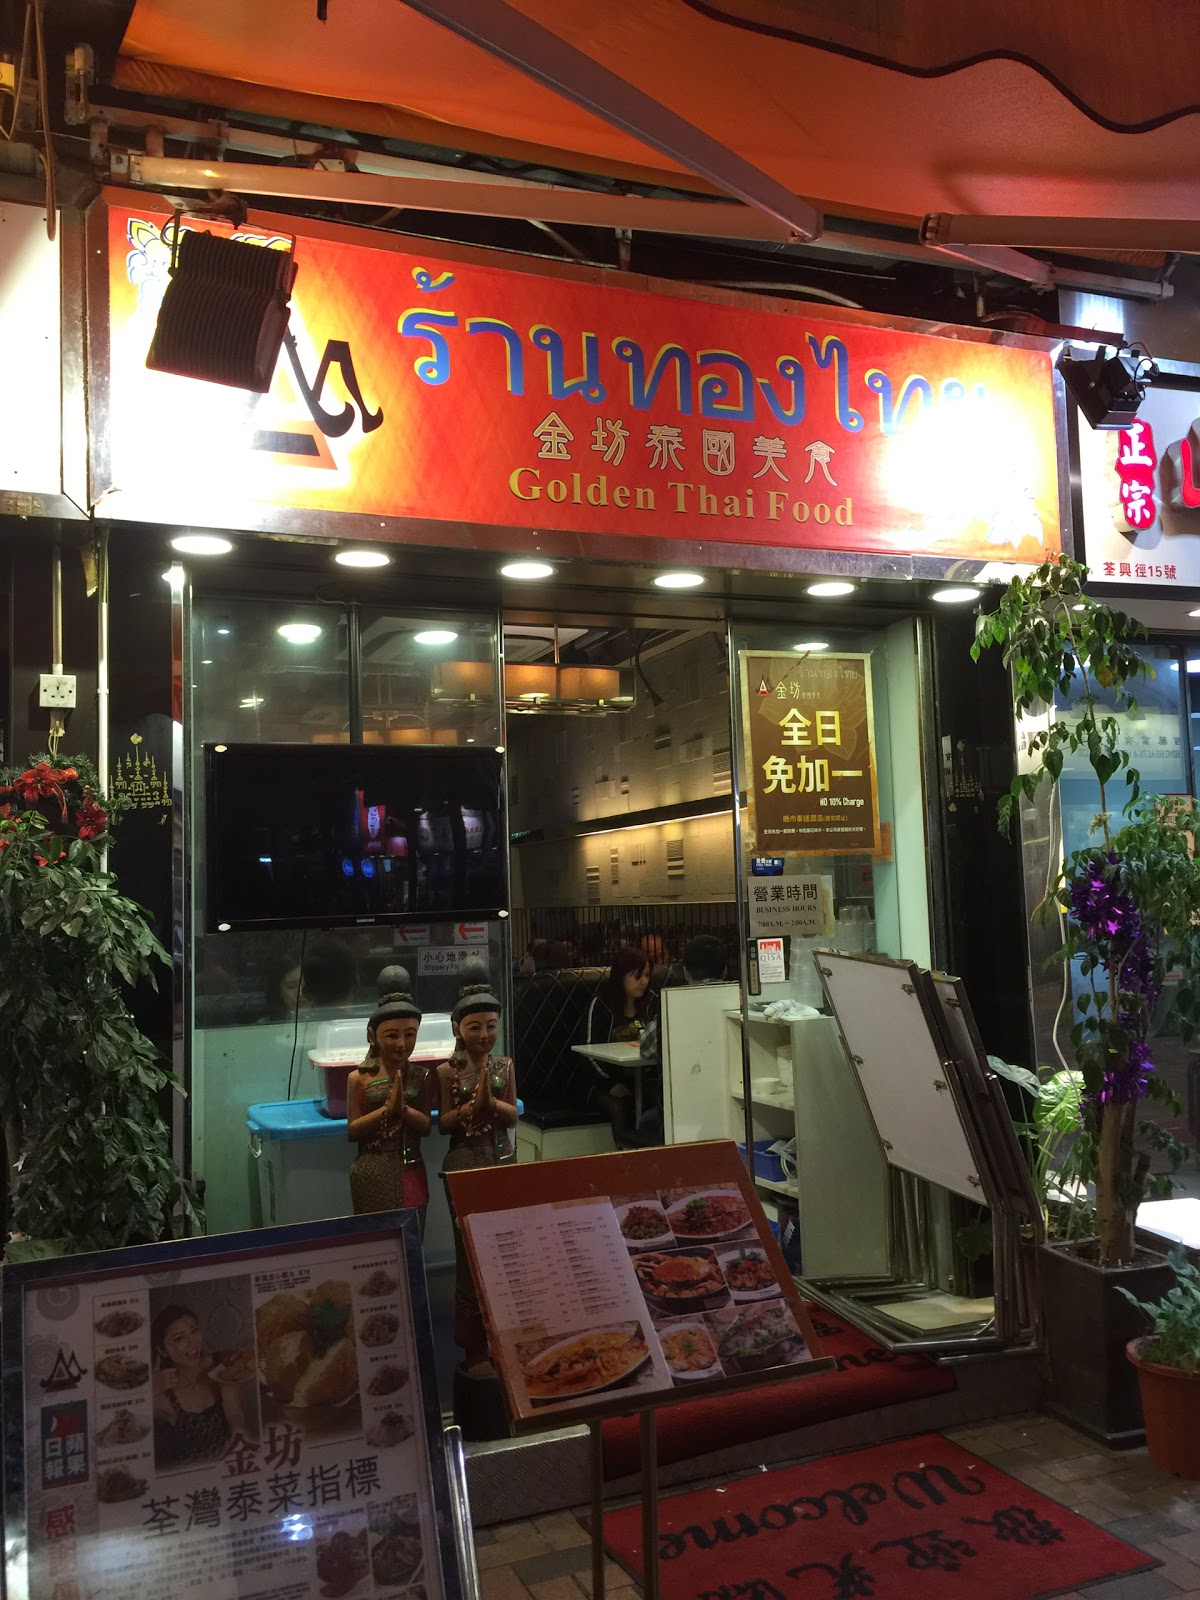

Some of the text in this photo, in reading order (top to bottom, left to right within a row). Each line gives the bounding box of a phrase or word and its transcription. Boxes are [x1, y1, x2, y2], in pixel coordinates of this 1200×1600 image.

[532, 411, 838, 487] 金坊泰國美食
[1120, 422, 1153, 524] 正宗
[508, 467, 855, 528] Golden Thai Food
[1103, 561, 1178, 579] 荃興徑15號
[775, 681, 801, 700] 金坊
[778, 707, 842, 746] 全日
[762, 755, 863, 794] 免加一
[829, 797, 842, 807] 10%
[843, 797, 864, 808] Charge
[753, 884, 818, 902] 營業時間
[756, 905, 790, 914] BUSINESS
[424, 963, 449, 972] Slippery
[222, 1424, 303, 1479] 金坊
[142, 1455, 382, 1540] 荃灣泰菜指標
[658, 1463, 986, 1560] Welcome
